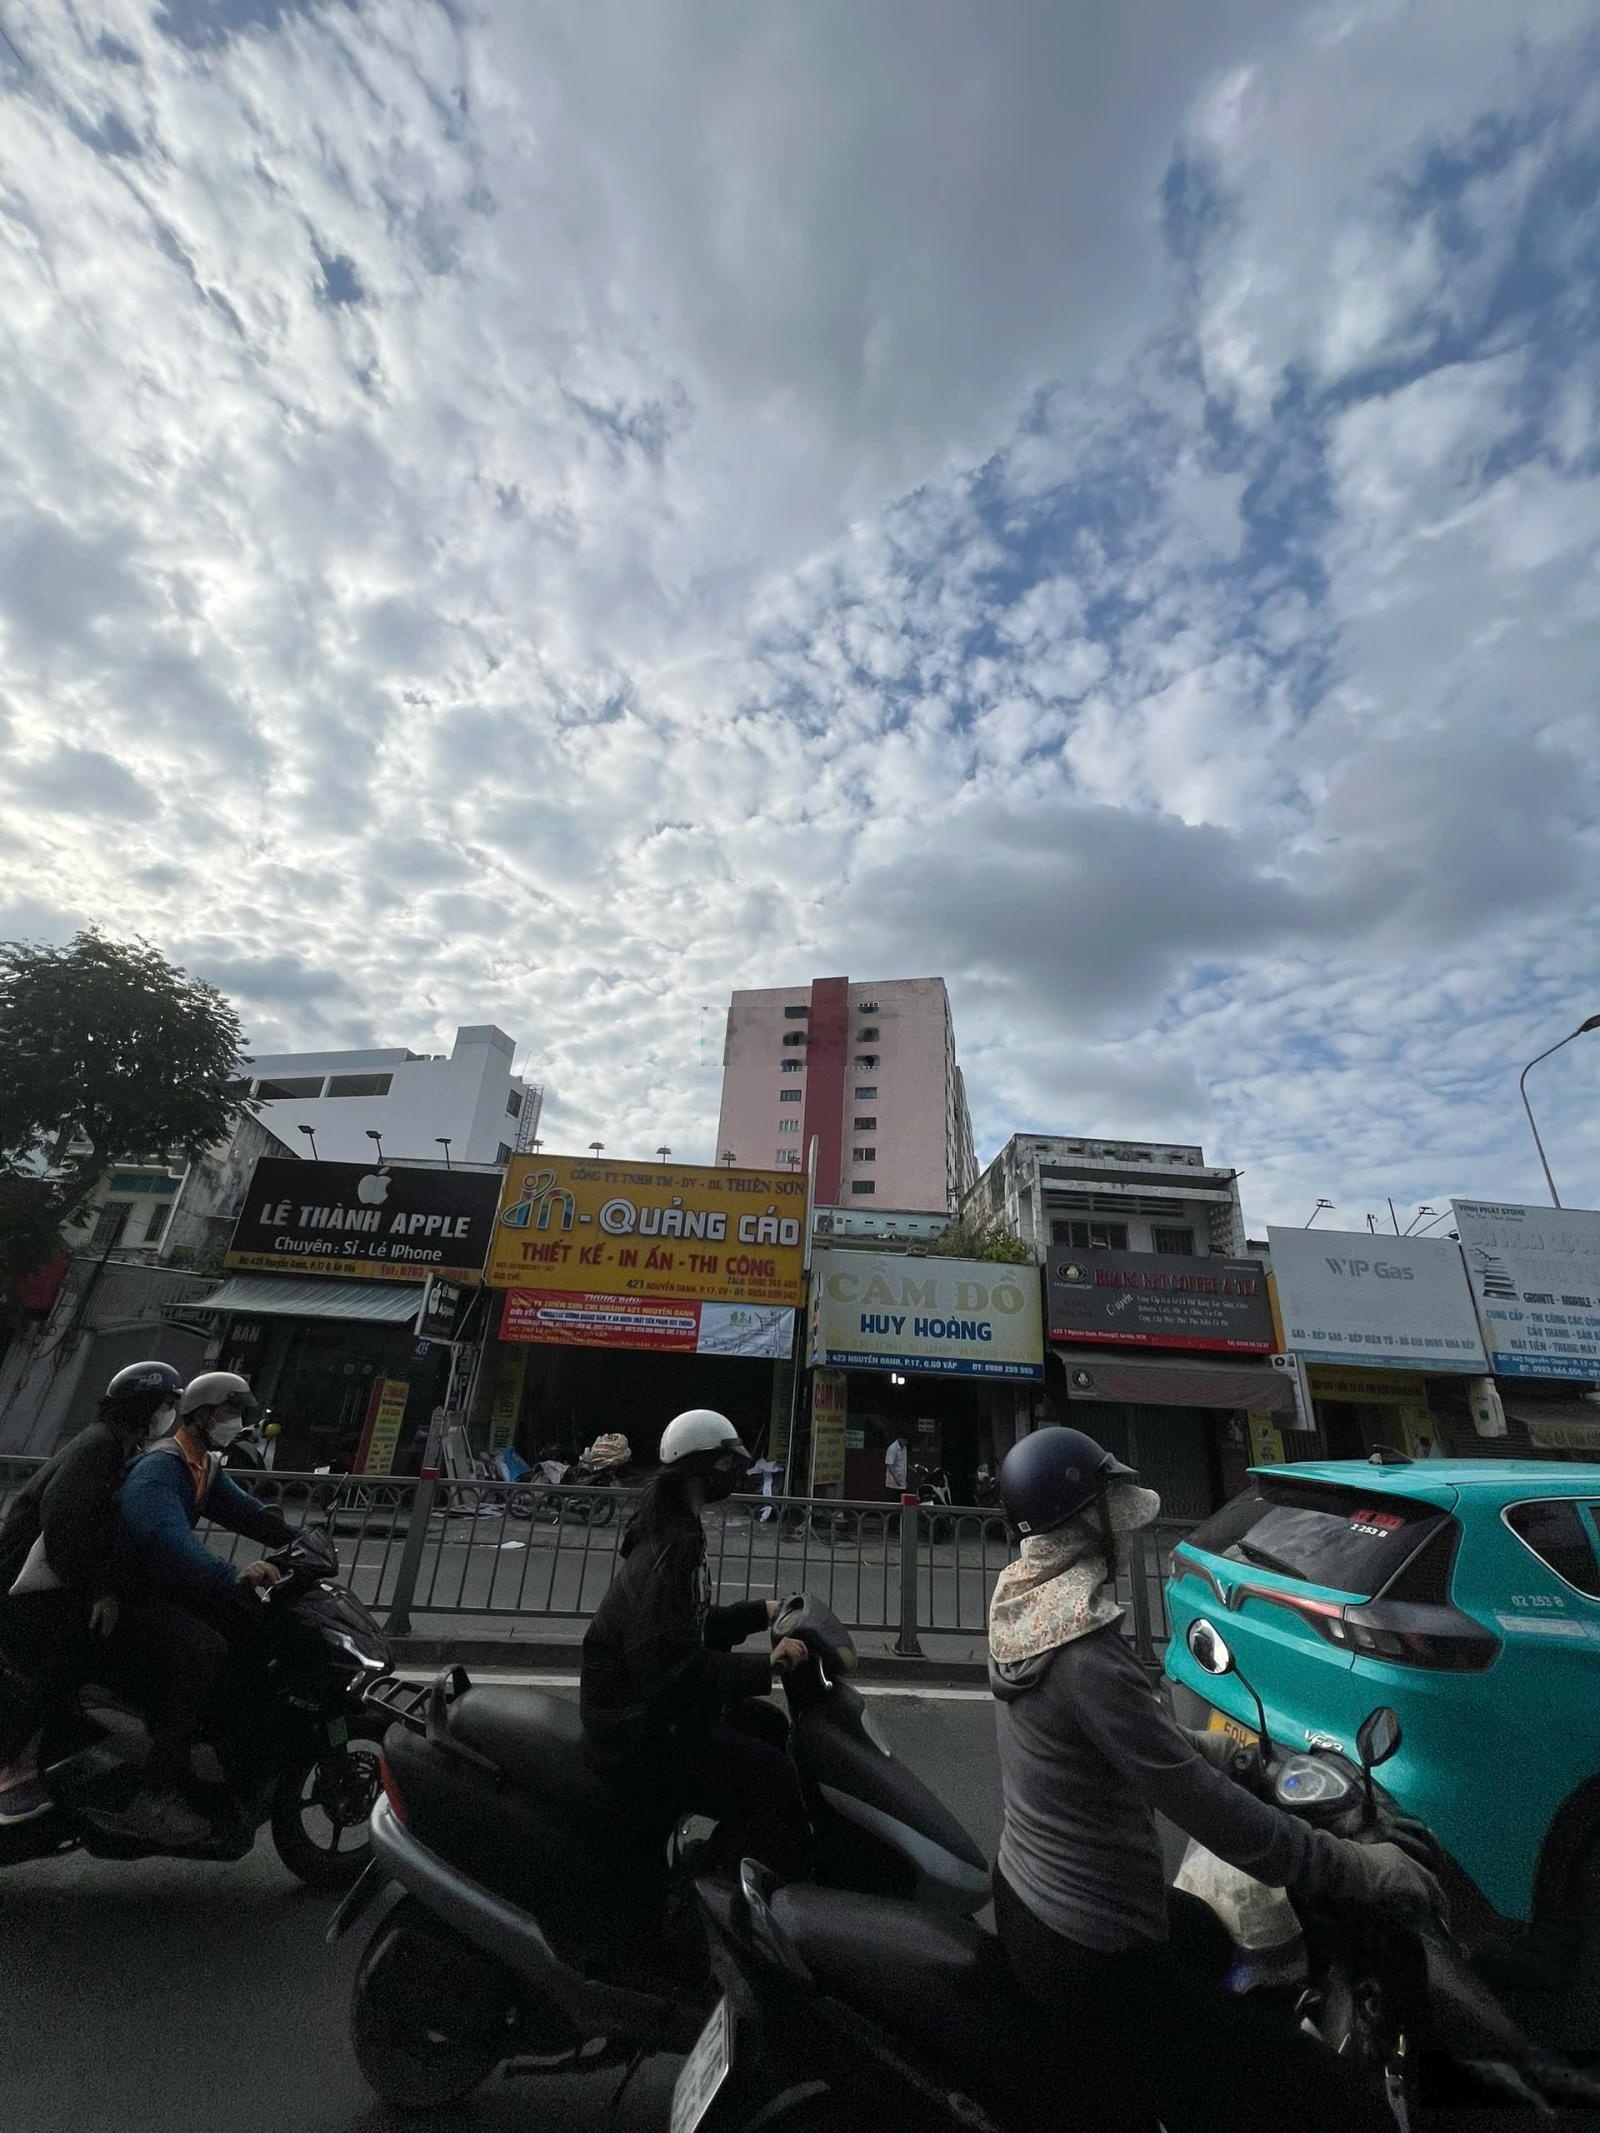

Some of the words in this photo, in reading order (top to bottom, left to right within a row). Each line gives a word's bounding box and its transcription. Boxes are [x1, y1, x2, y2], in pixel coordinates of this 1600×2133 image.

[259, 1200, 293, 1226] LÊ
[298, 1203, 382, 1233] THÀNH
[388, 1211, 471, 1239] APPLE
[600, 1196, 728, 1241] QUẢNG
[739, 1206, 801, 1246] CÁO
[522, 1239, 572, 1264] THIẾT
[579, 1241, 606, 1265] KẾ
[618, 1248, 638, 1268] IN
[645, 1246, 674, 1271] ẤN
[689, 1254, 718, 1274] THI
[725, 1254, 776, 1278] CÔNG
[1374, 1262, 1415, 1281] Gas
[626, 1279, 645, 1289] 421
[860, 1314, 907, 1336] HUY
[914, 1316, 993, 1342] HOÀNG
